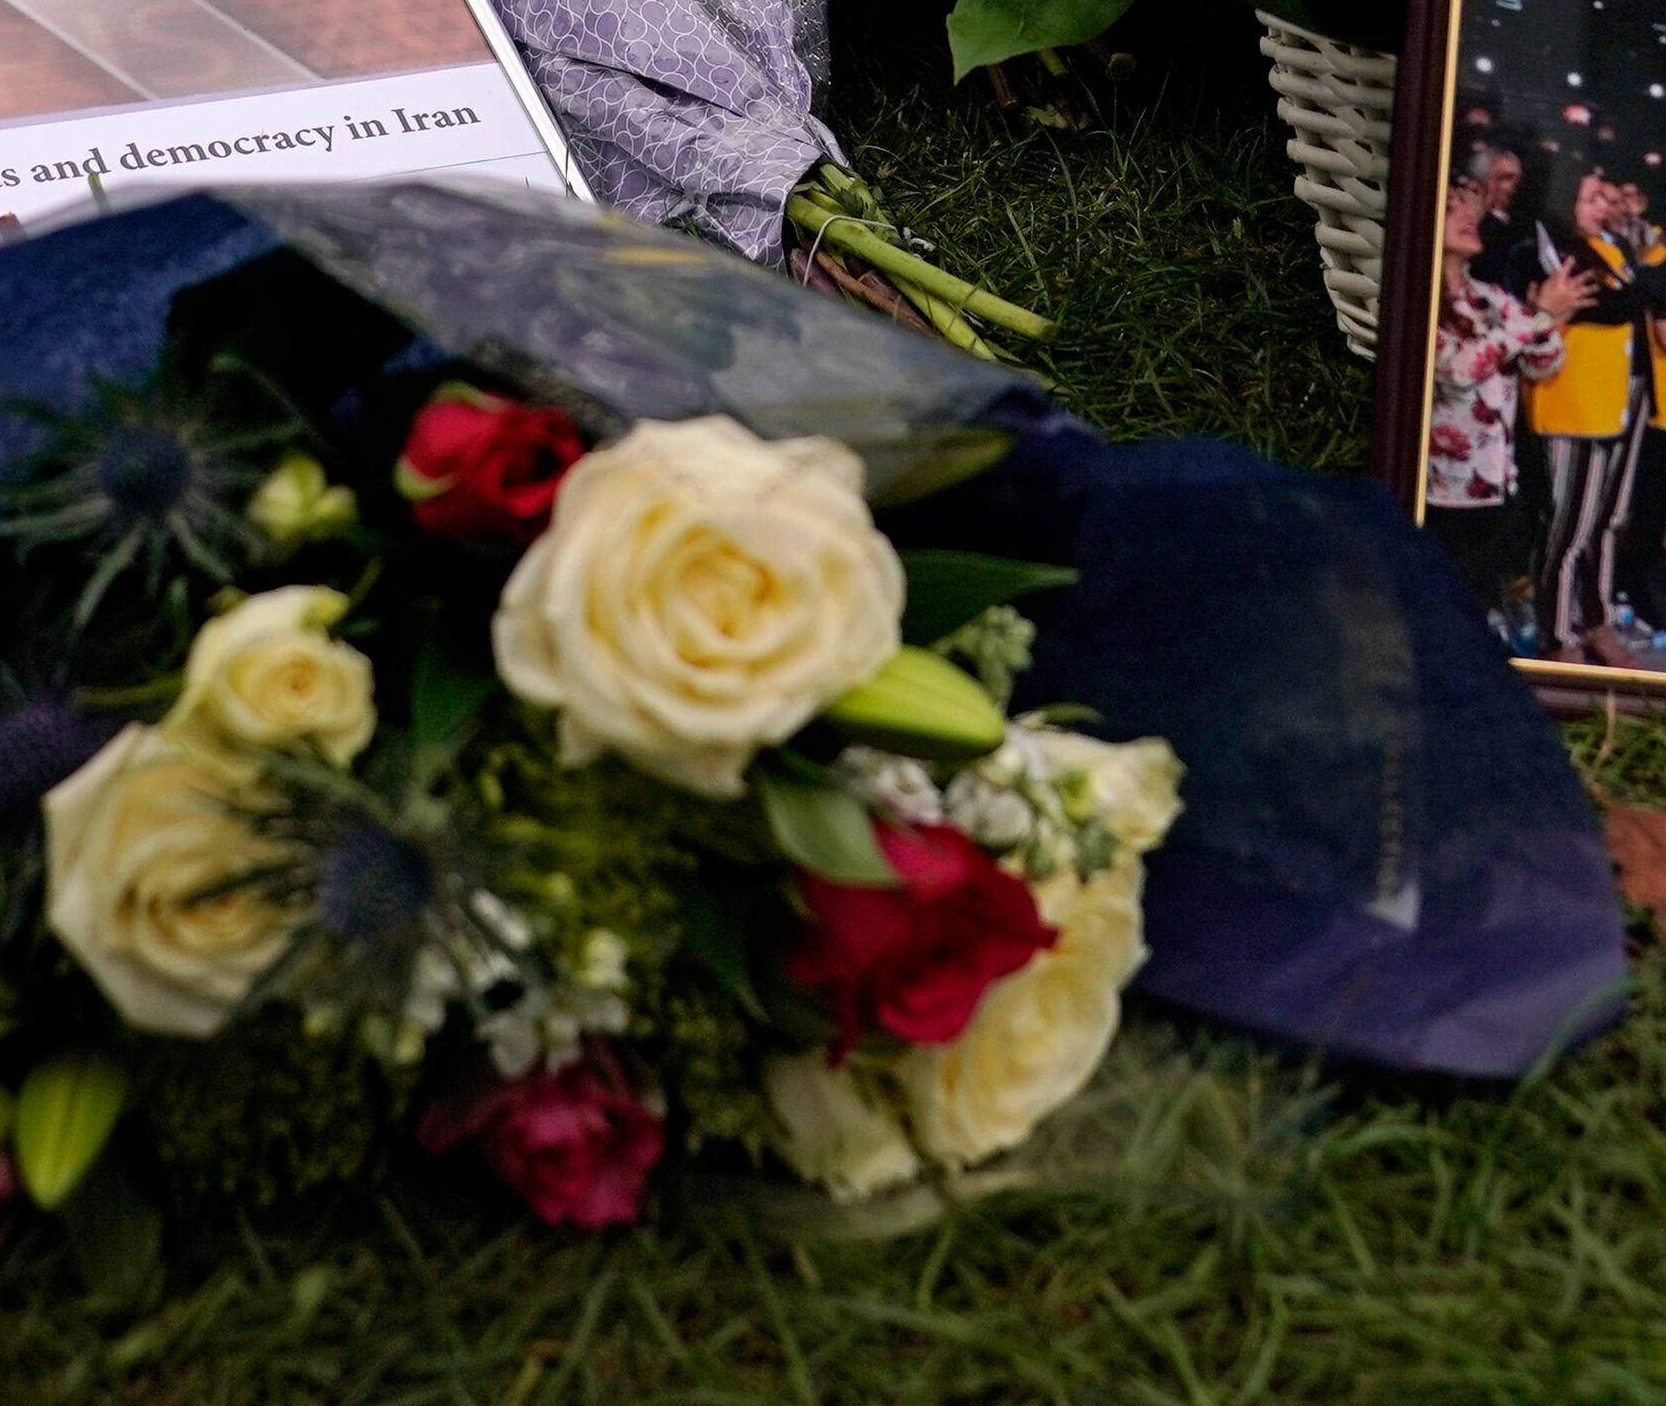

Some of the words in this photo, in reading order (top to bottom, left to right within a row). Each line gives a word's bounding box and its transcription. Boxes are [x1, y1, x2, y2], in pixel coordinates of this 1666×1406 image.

[31, 149, 108, 186] and
[120, 117, 339, 174] democracy
[349, 111, 389, 142] in
[398, 100, 483, 137] Iran
